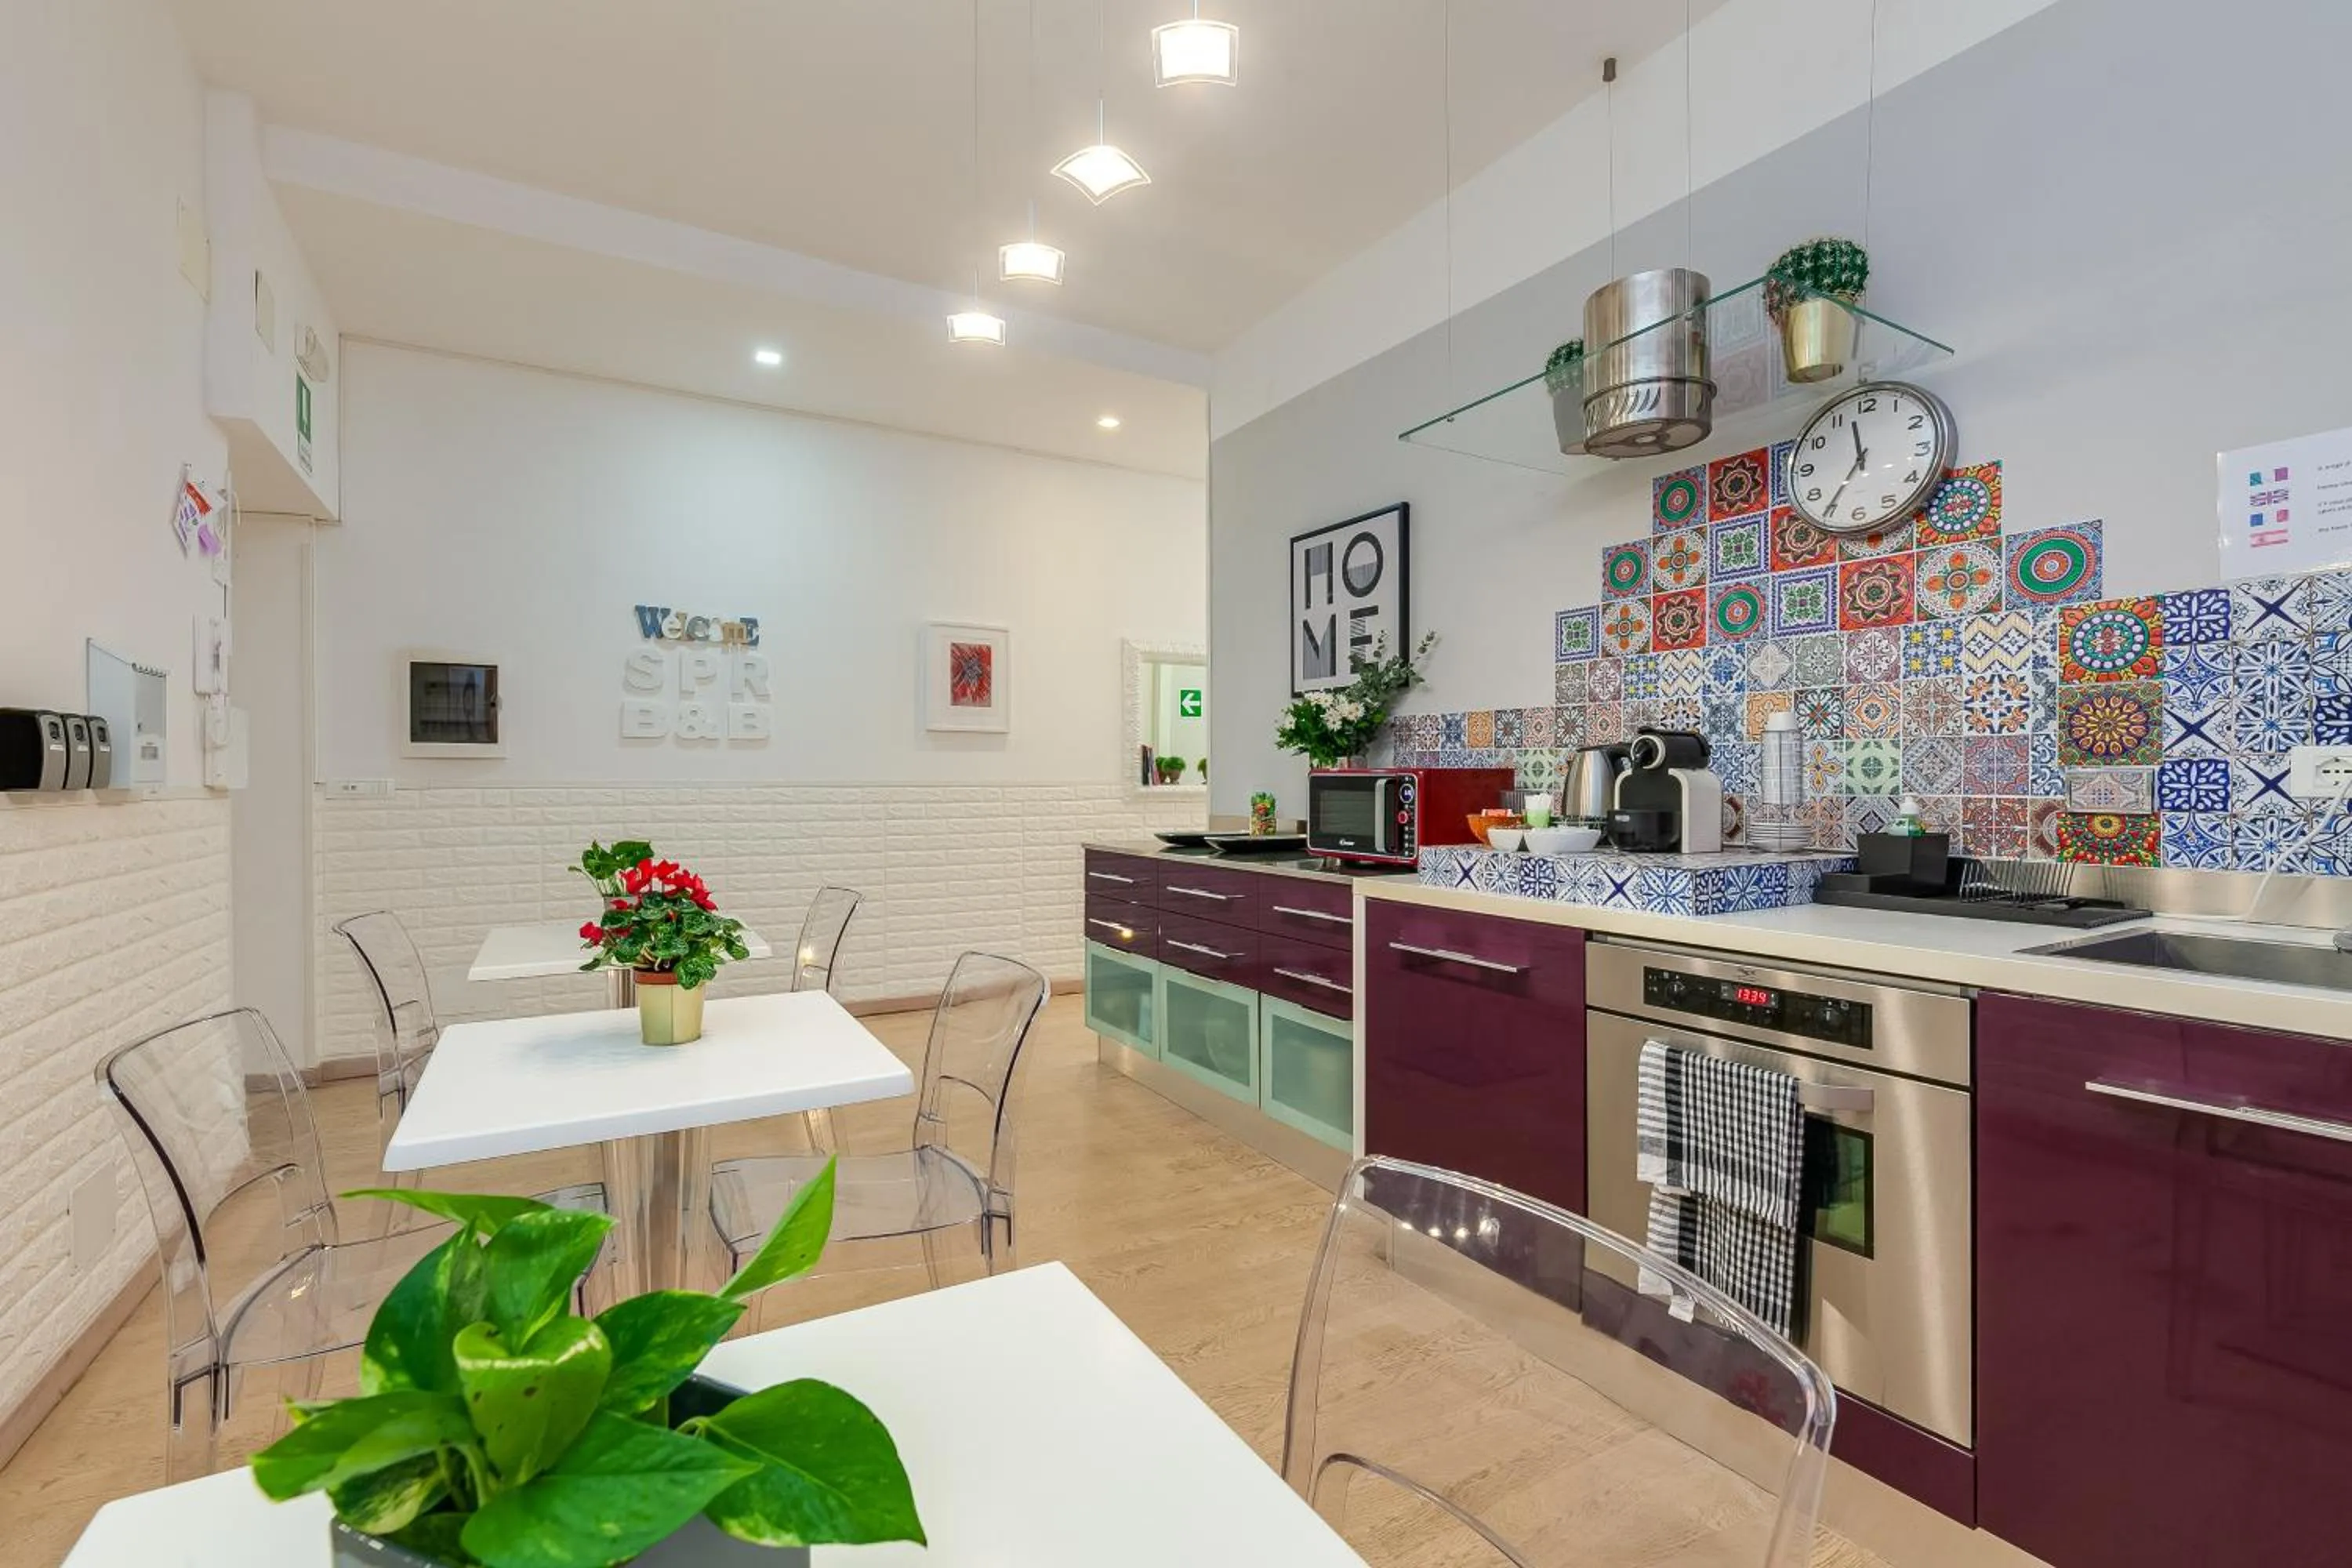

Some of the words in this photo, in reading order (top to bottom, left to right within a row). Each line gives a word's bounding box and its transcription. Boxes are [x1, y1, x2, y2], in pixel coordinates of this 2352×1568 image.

[1857, 398, 1877, 414] 12
[1893, 399, 1898, 413] 1
[1832, 414, 1843, 428] 11
[1907, 416, 1924, 430] 2
[1811, 436, 1826, 450] 10
[1915, 441, 1930, 456] 3
[1799, 463, 1814, 477] 9
[1904, 470, 1920, 484] 4
[1806, 488, 1822, 501] 8
[1882, 495, 1896, 508] 5
[1851, 506, 1866, 521] 6
[626, 647, 771, 697] SPR
[622, 699, 771, 740] B&B
